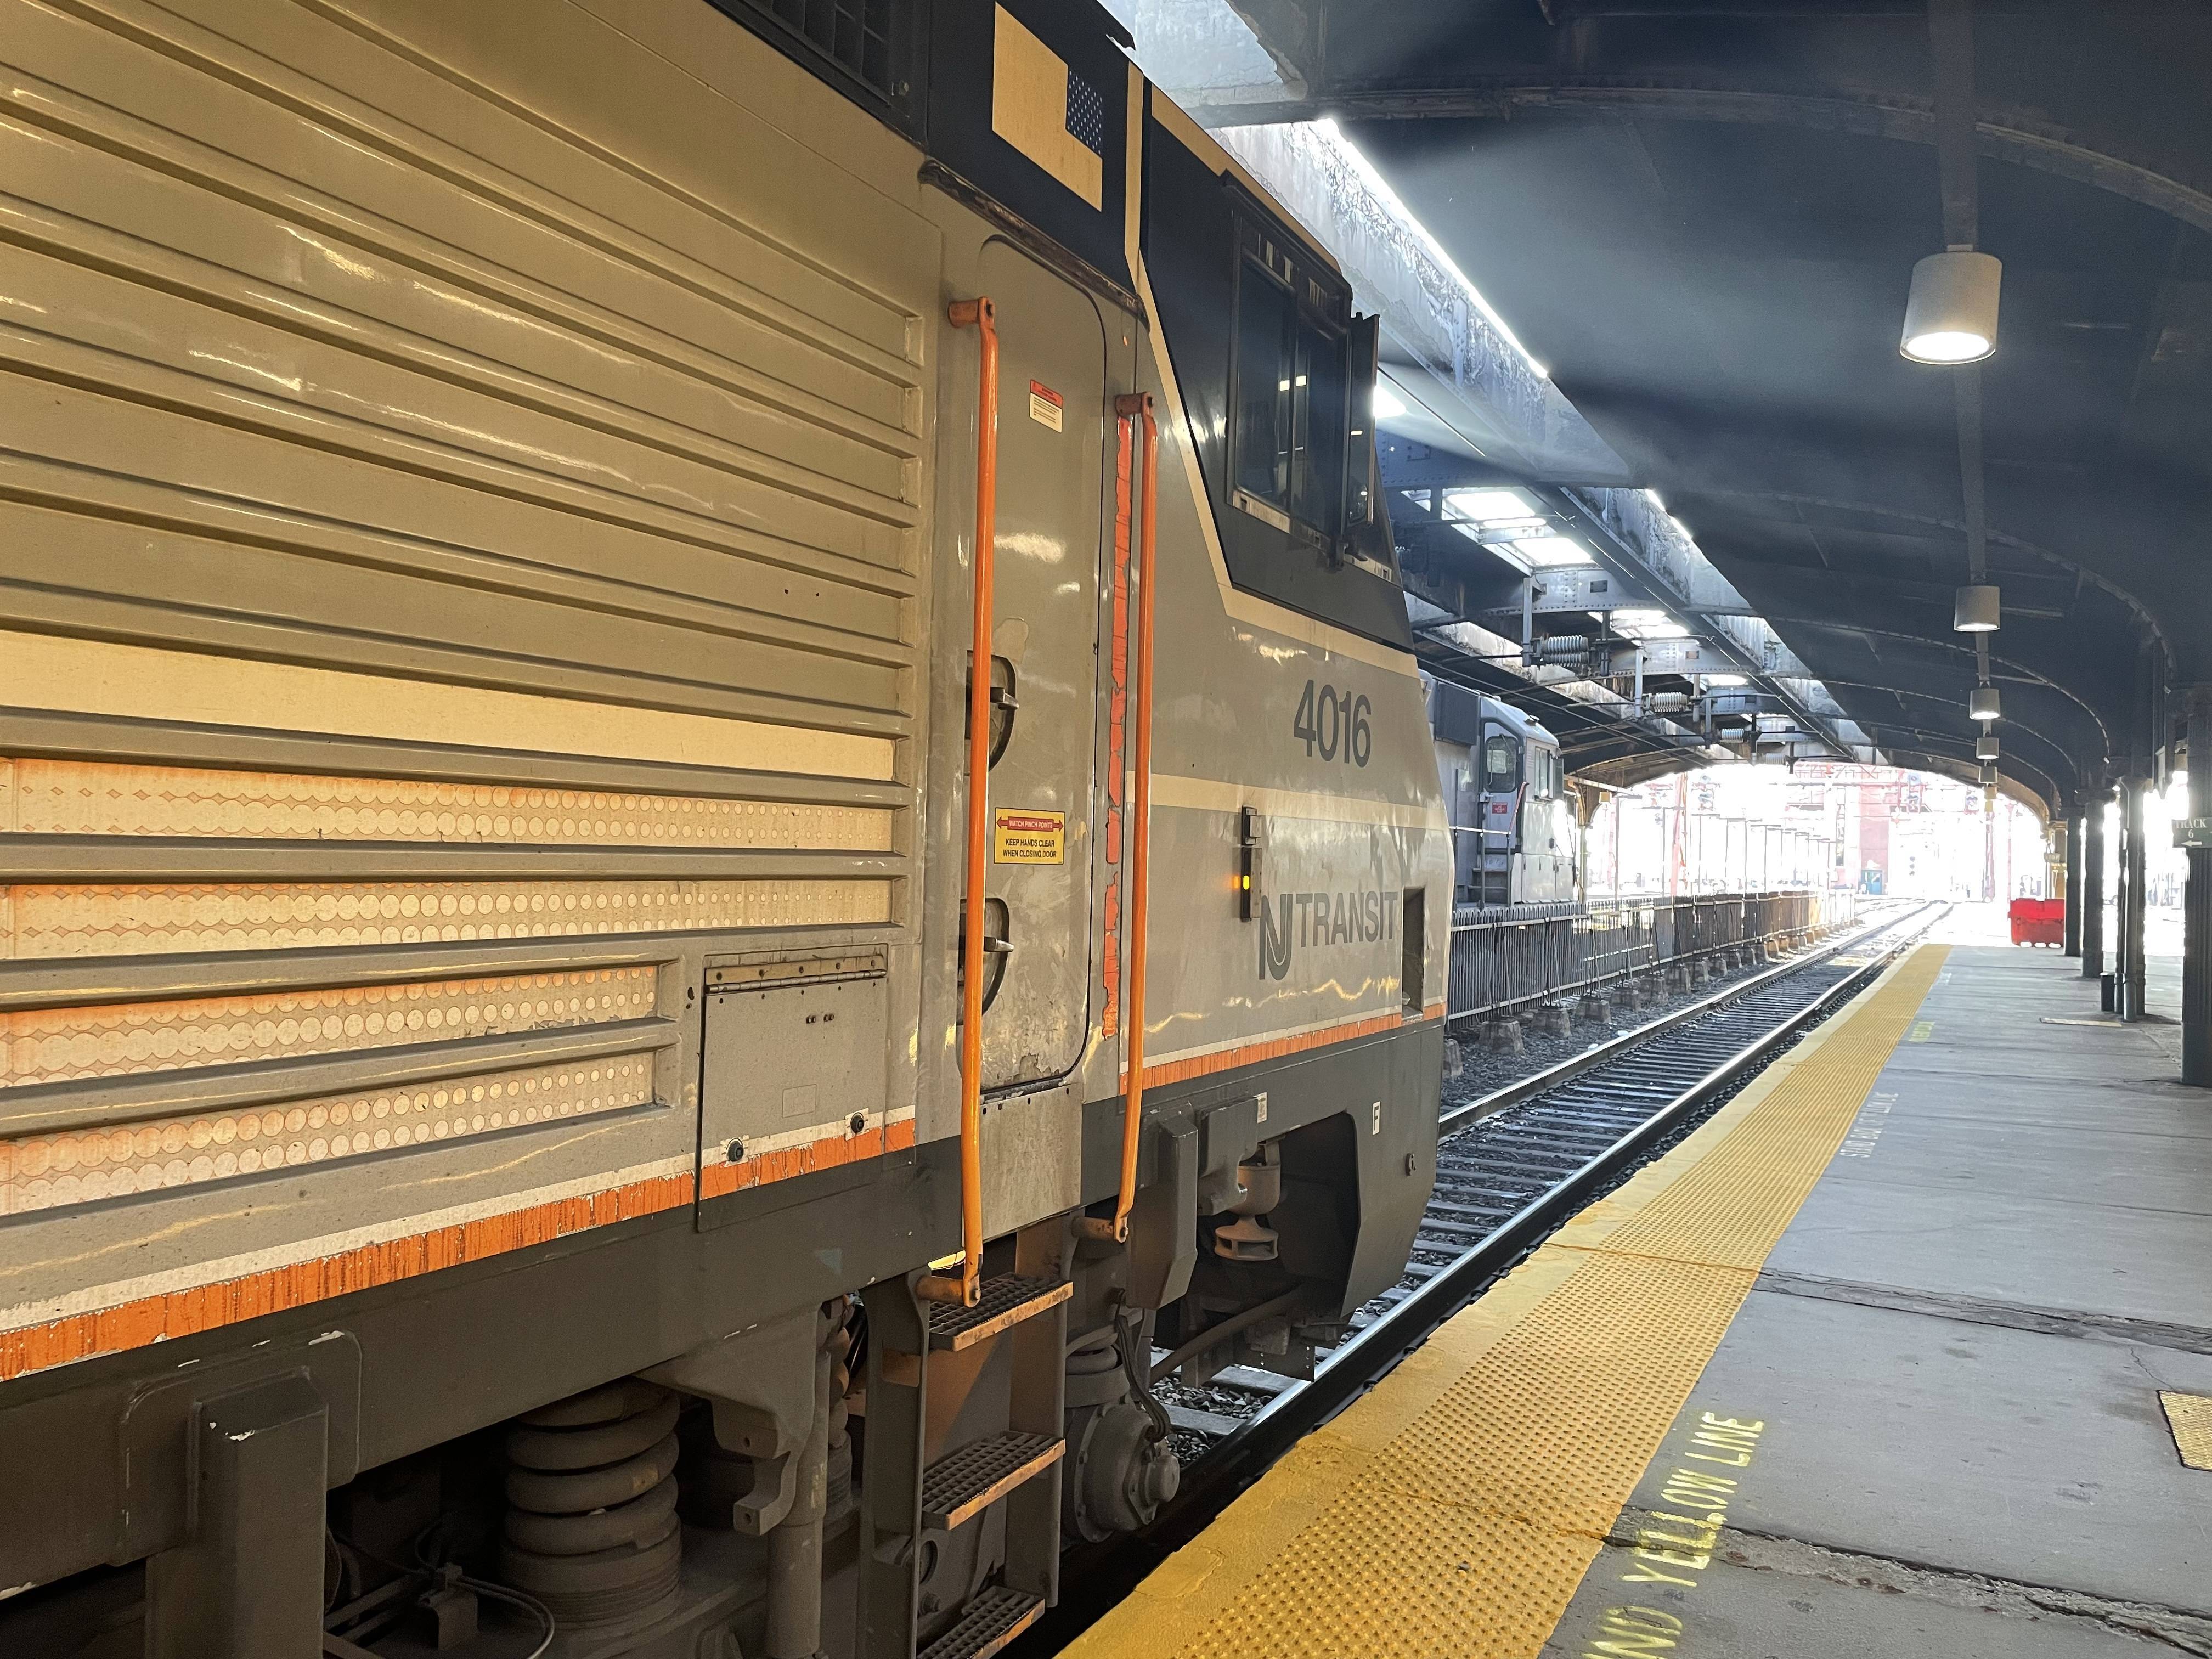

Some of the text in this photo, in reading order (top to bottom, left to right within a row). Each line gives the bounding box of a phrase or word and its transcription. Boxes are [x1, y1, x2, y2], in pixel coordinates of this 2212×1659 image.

[1294, 679, 1371, 768] 4016
[2176, 819, 2207, 828] TRACK
[2188, 829, 2194, 838] 6
[1259, 891, 1398, 981] NJ TRANSIT
[1373, 1105, 1379, 1131] F
[1621, 1468, 1738, 1587] YELLOW
[1685, 1412, 1764, 1467] LINE
